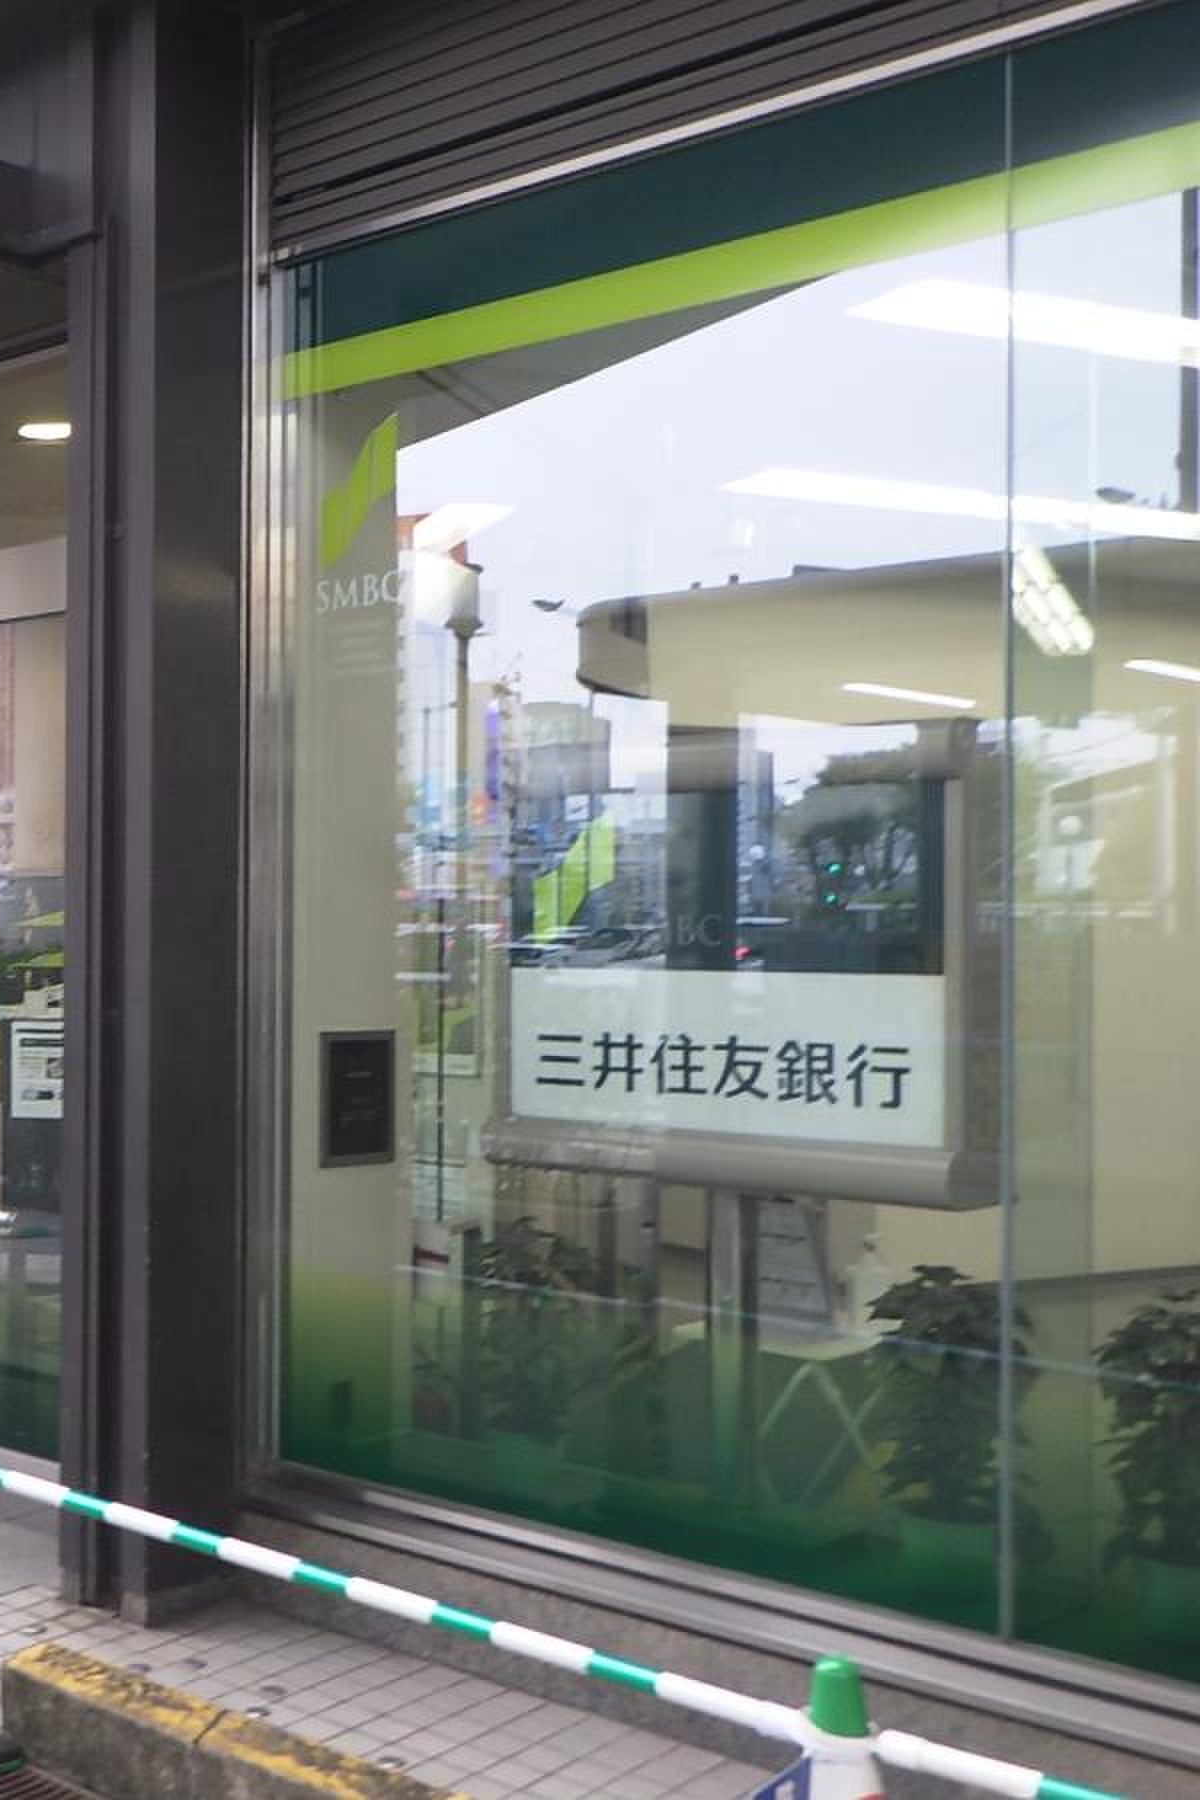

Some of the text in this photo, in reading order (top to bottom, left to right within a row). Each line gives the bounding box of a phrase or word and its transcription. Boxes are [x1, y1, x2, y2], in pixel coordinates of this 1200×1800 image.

[316, 569, 404, 614] SMBC
[535, 1032, 912, 1109] 三井住友銀行
